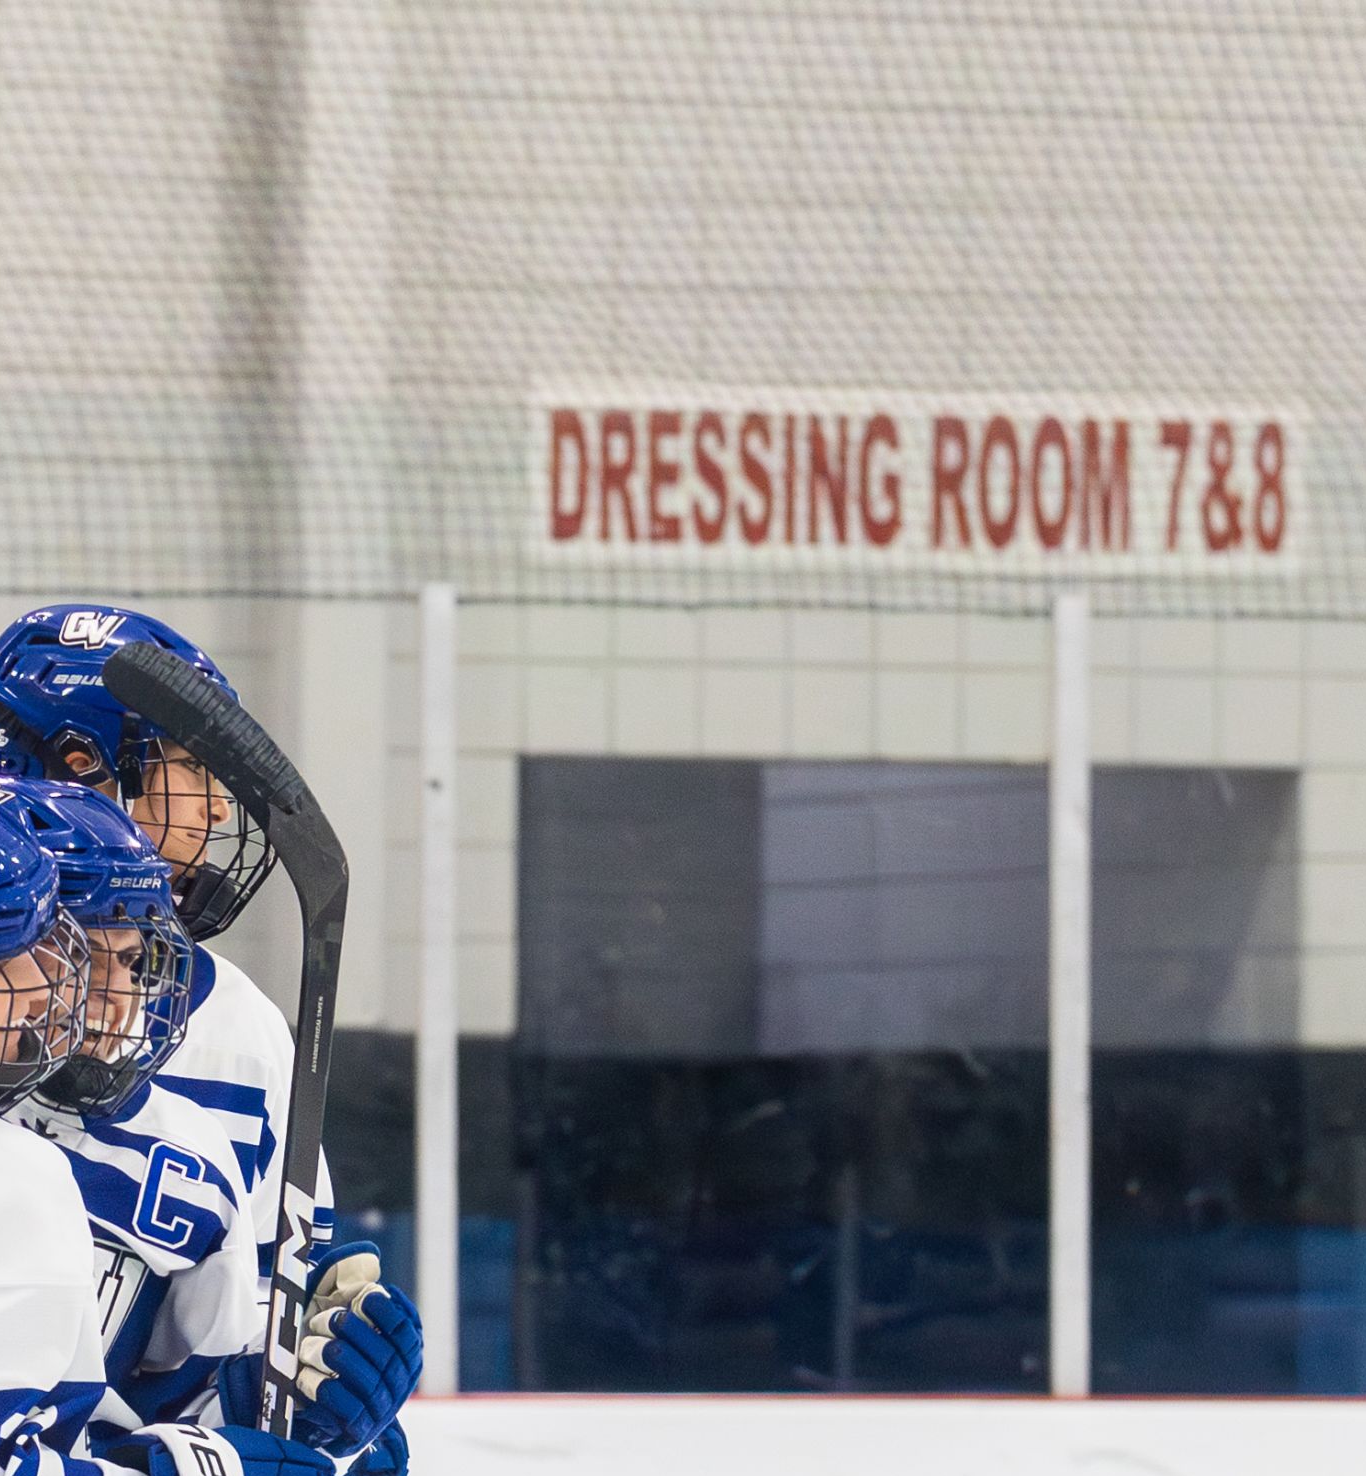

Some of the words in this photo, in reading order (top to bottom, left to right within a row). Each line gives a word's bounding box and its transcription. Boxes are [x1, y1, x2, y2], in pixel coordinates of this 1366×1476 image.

[549, 409, 902, 547] DRESSING
[931, 414, 1130, 553] ROOM
[1160, 420, 1286, 555] 7&8
[59, 611, 126, 650] GV
[53, 674, 106, 686] BAUE
[109, 876, 163, 889] BAUER
[132, 1141, 206, 1250] C
